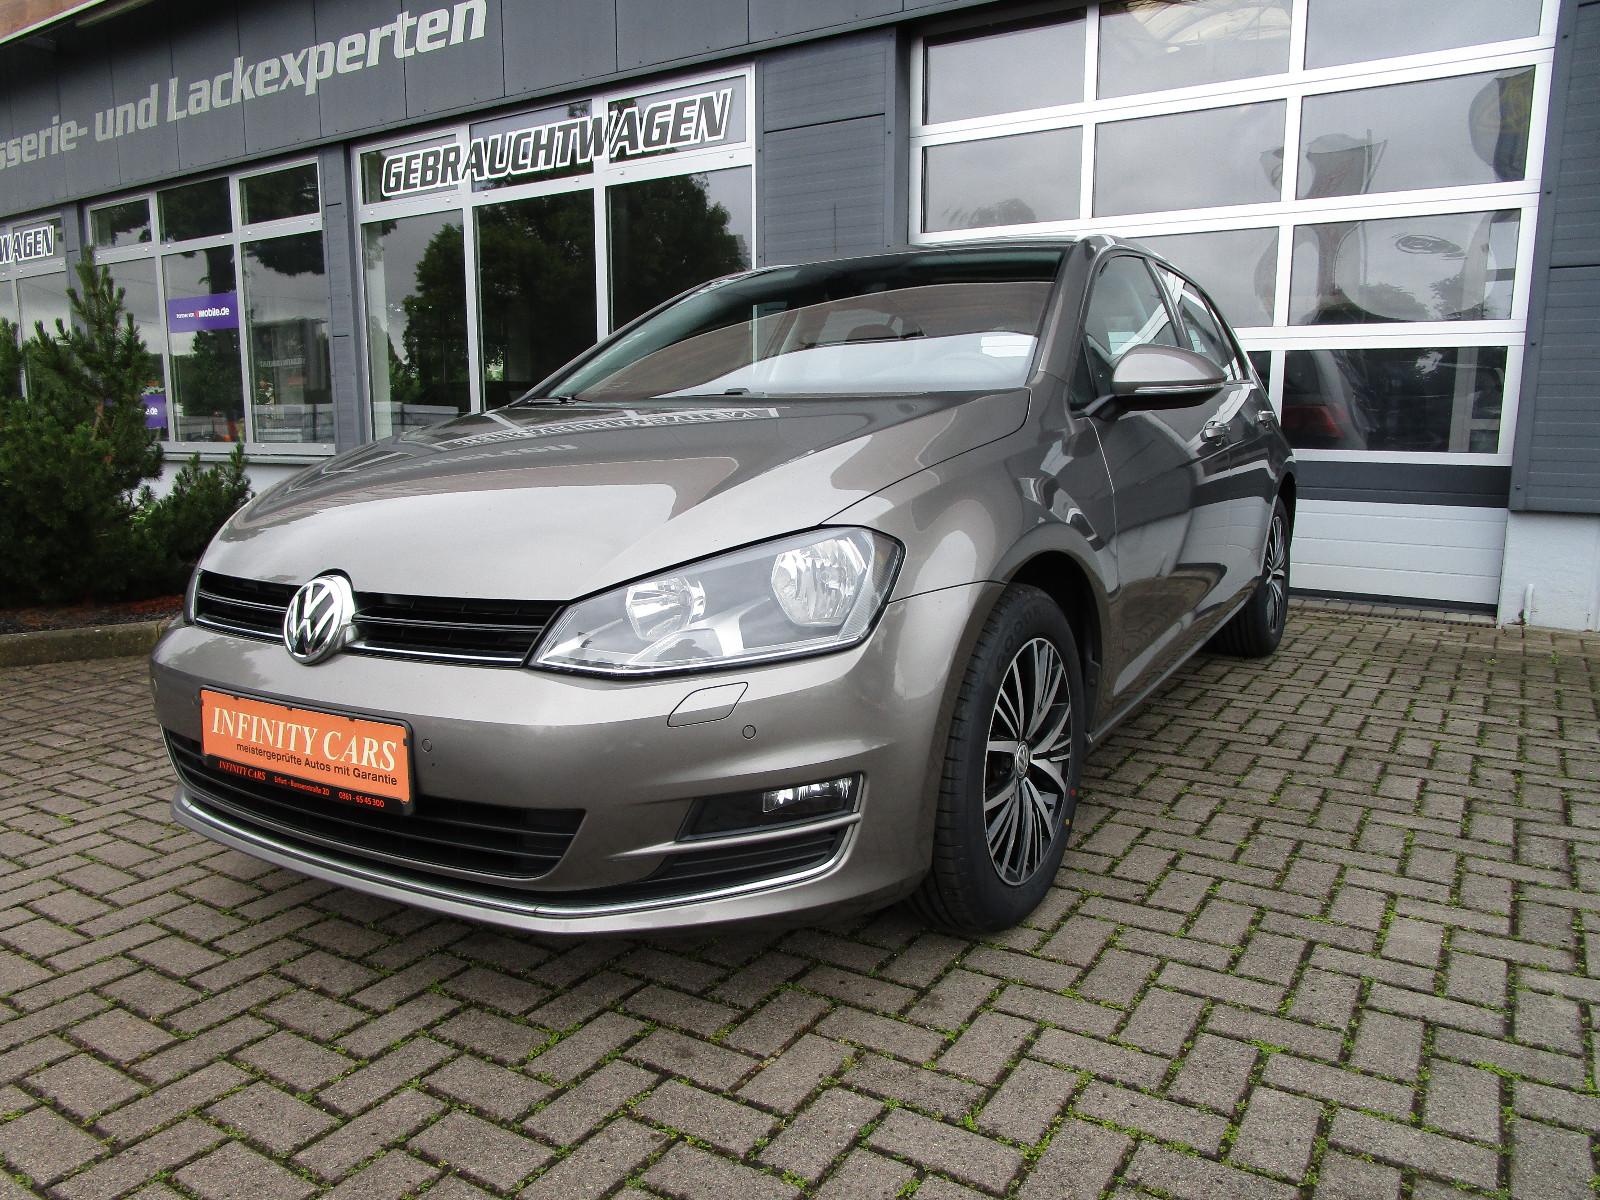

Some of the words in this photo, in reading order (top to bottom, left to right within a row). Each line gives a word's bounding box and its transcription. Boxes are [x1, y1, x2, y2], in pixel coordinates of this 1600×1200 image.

[95, 83, 160, 142] und
[166, 0, 488, 122] Lackexperten
[381, 87, 733, 197] GEBRAUCHTWAGEN
[198, 306, 230, 318] mobile.de
[211, 706, 318, 756] INFINITY
[323, 730, 397, 772] CARS
[236, 742, 302, 767] meistergeprüfte
[304, 757, 332, 772] Autos
[333, 766, 351, 777] mit
[352, 767, 398, 786] Garantie
[218, 760, 248, 777] INFINITY
[248, 768, 266, 781] CARS
